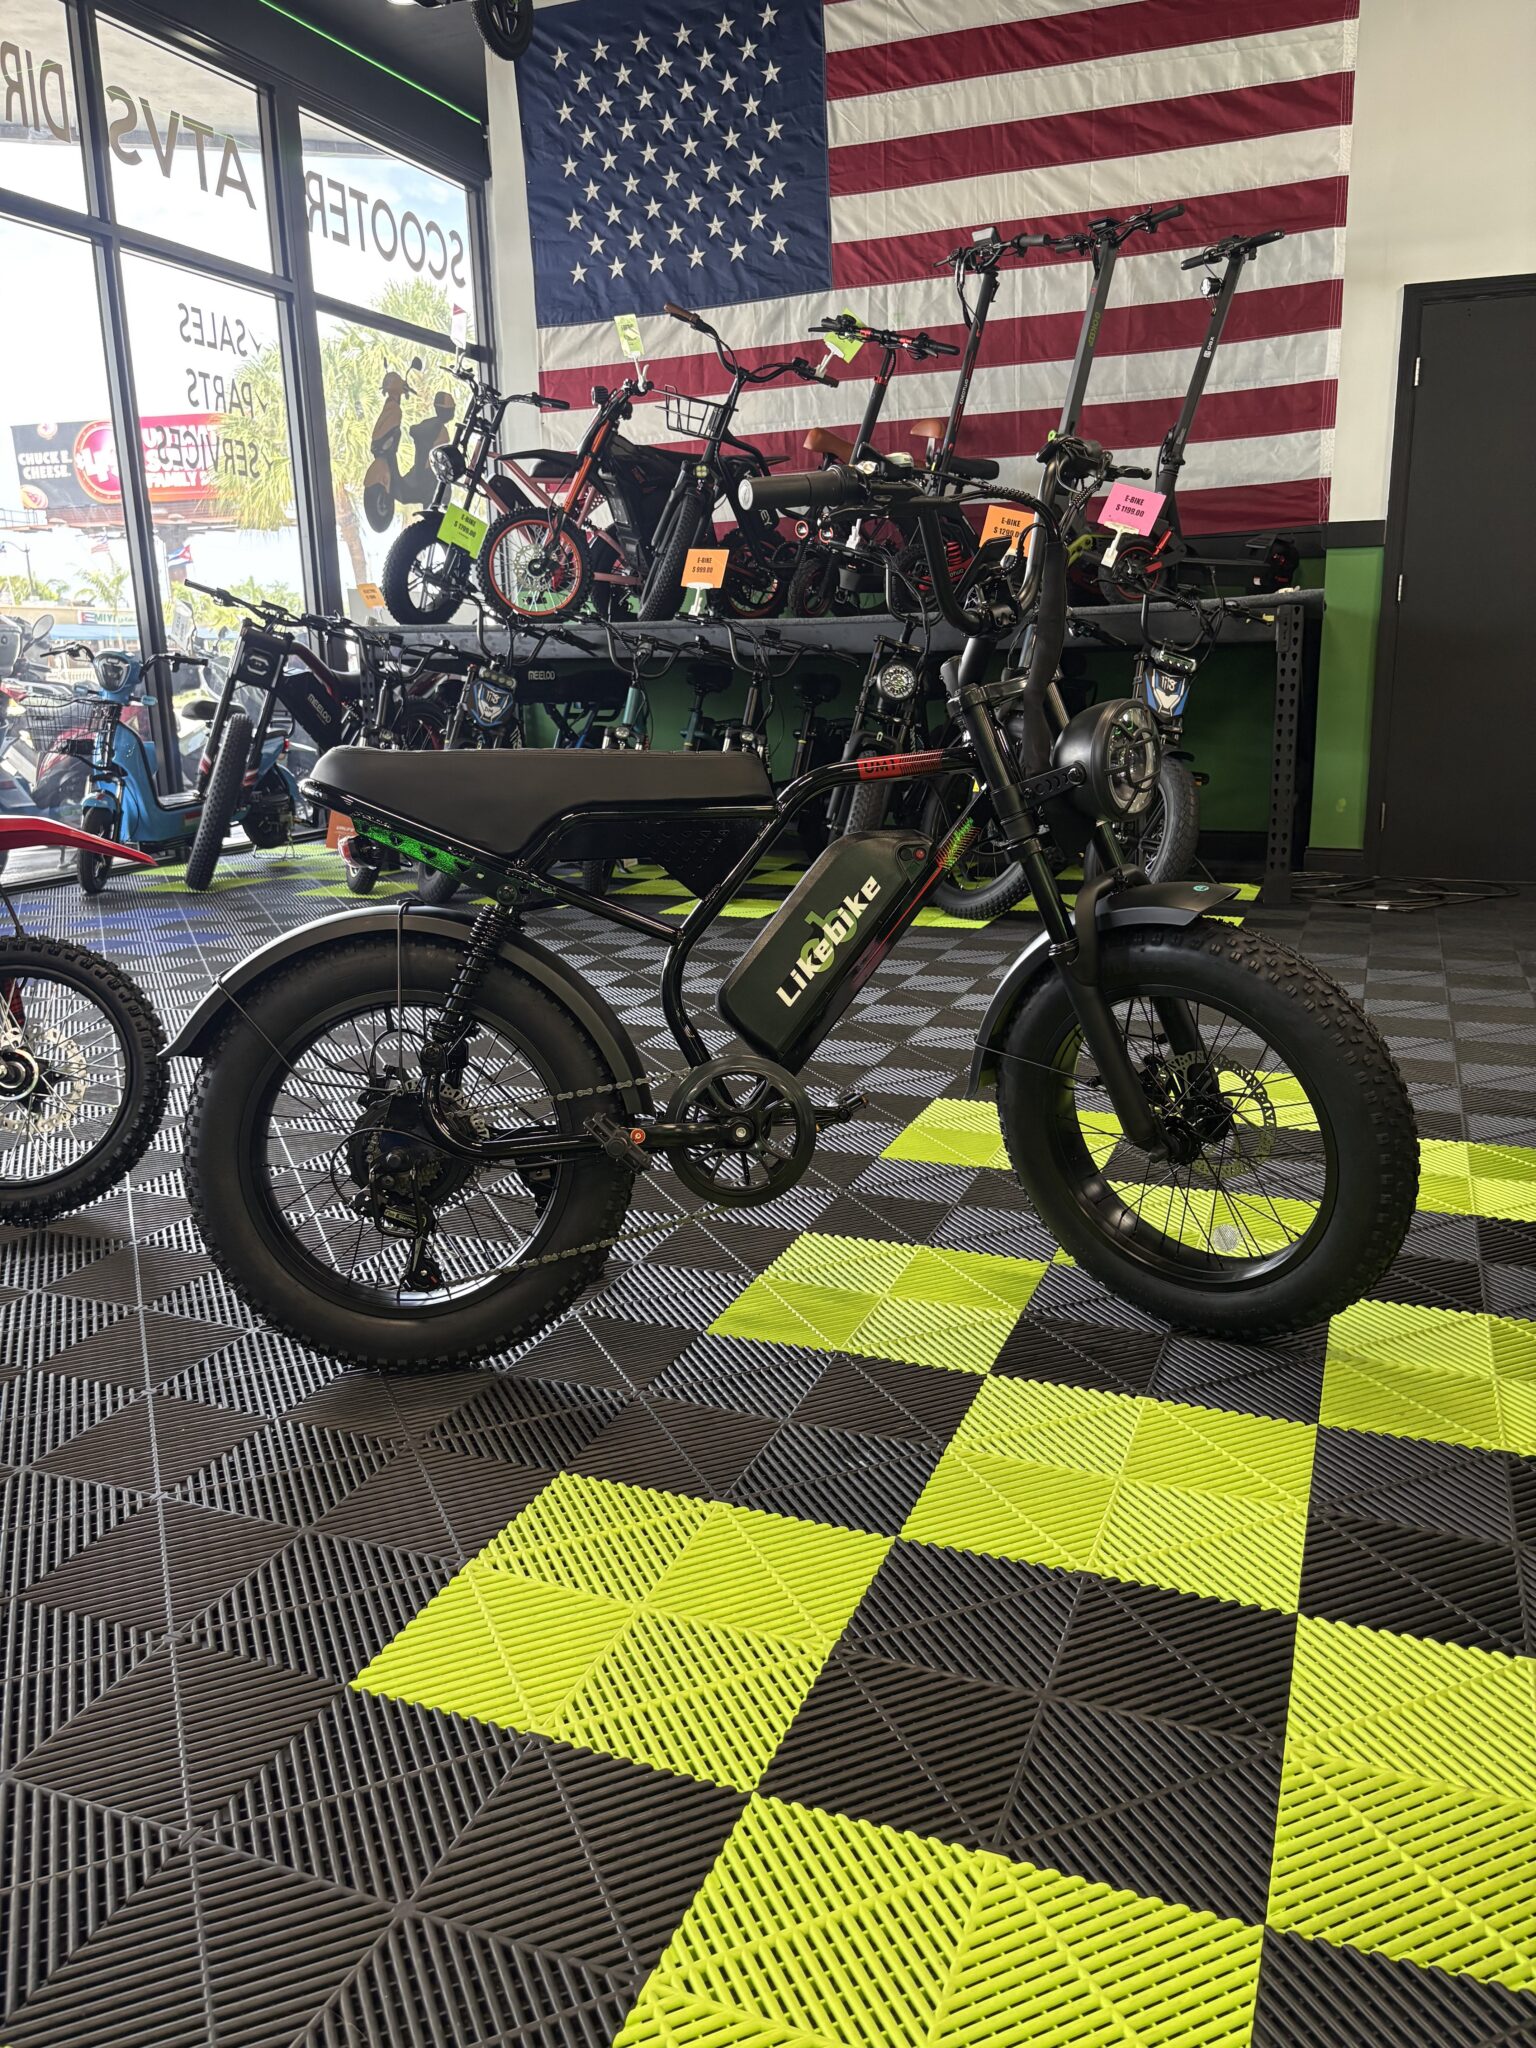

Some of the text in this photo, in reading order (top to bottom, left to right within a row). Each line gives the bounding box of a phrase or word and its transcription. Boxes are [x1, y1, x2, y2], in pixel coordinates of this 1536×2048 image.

[18, 451, 61, 466] CHUCK
[1124, 494, 1145, 506] E-BIKE
[1121, 505, 1145, 518] 1199.00
[1001, 517, 1021, 528] E-BIKE
[999, 528, 1022, 539] 1299.0
